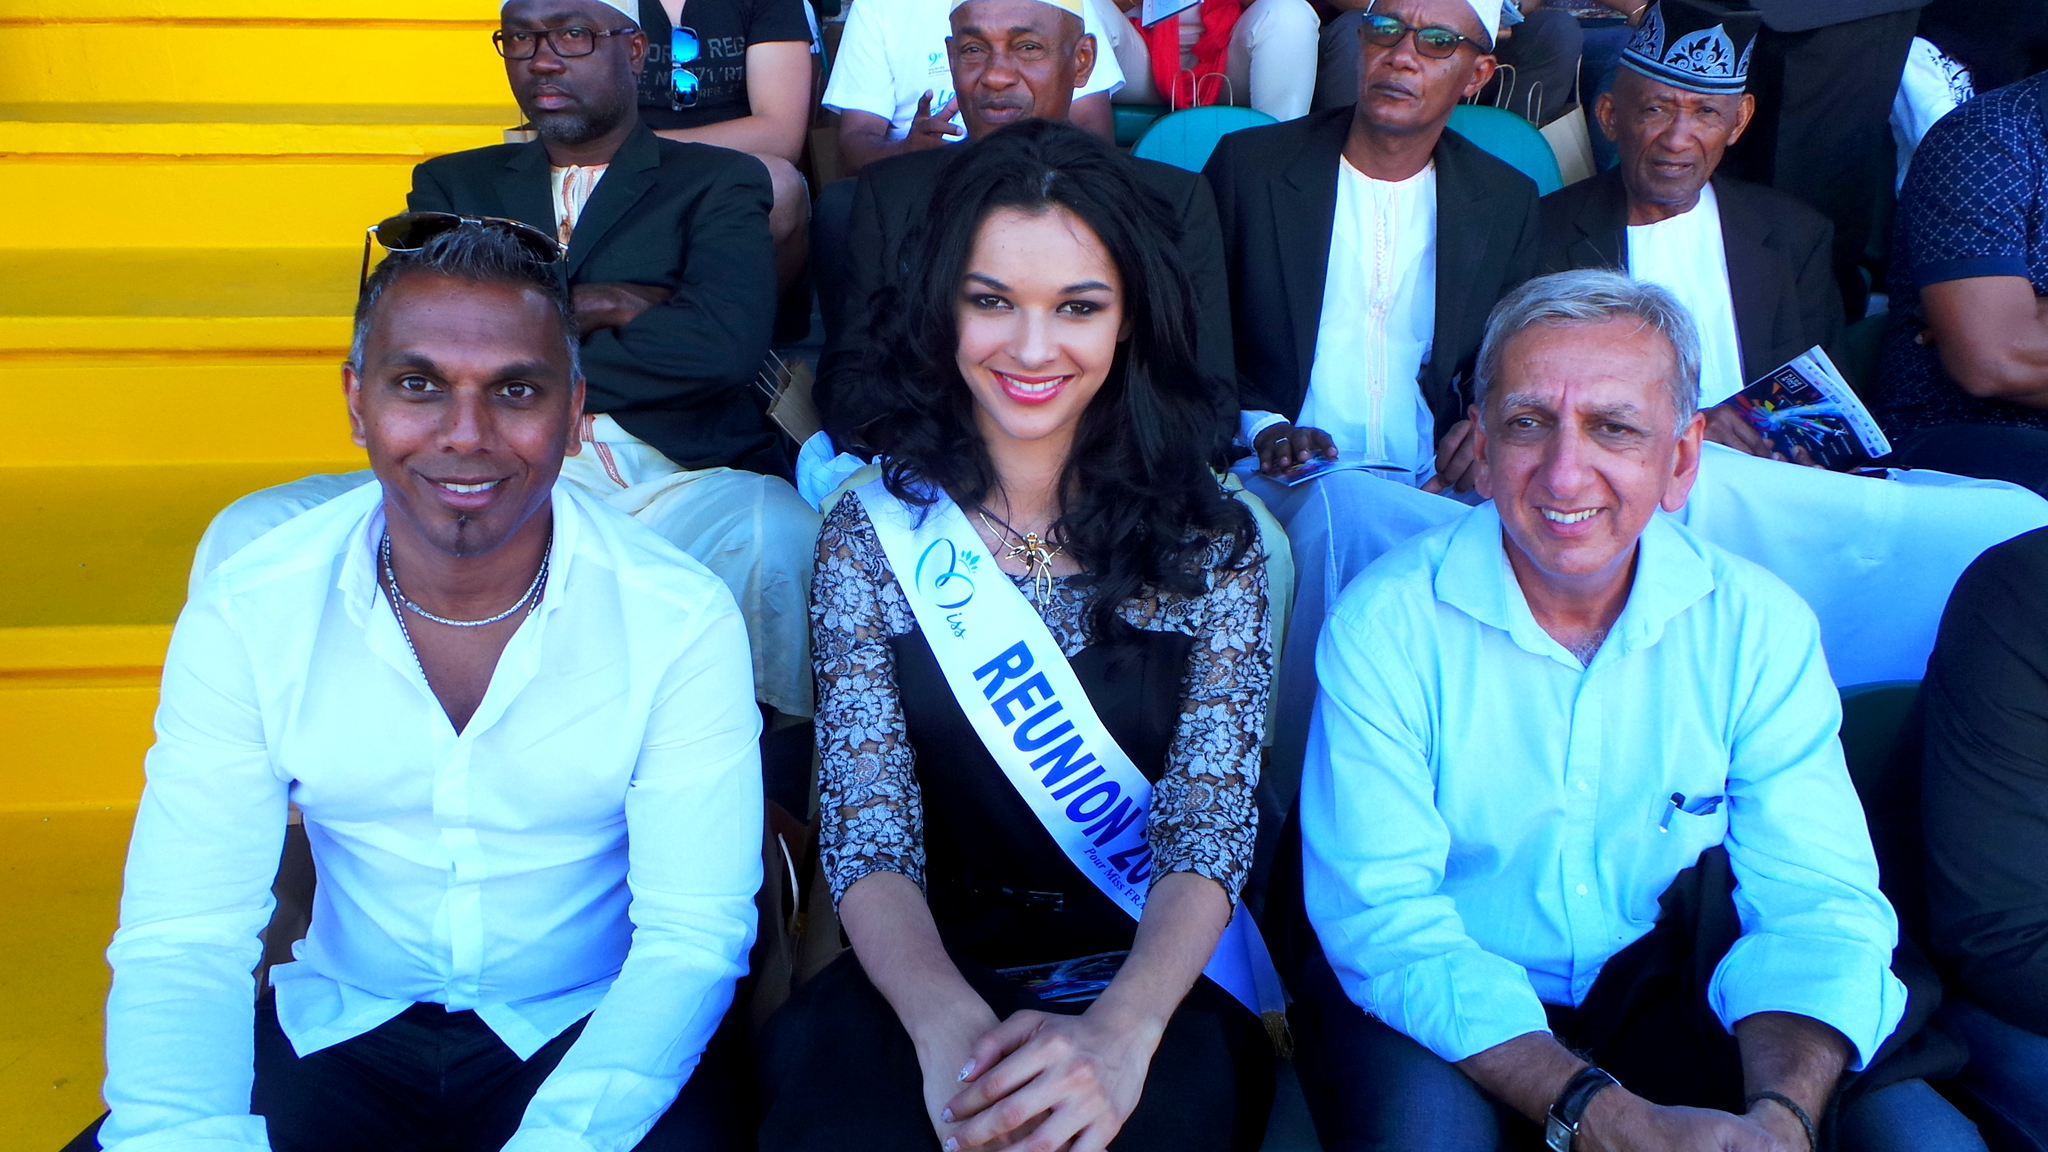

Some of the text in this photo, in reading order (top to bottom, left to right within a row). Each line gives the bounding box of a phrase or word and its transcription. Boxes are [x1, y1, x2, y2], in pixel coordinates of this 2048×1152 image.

[707, 36, 745, 59] REG
[972, 640, 1143, 848] REUNION
[1084, 847, 1106, 869] Pour
[1103, 868, 1125, 891] Miss
